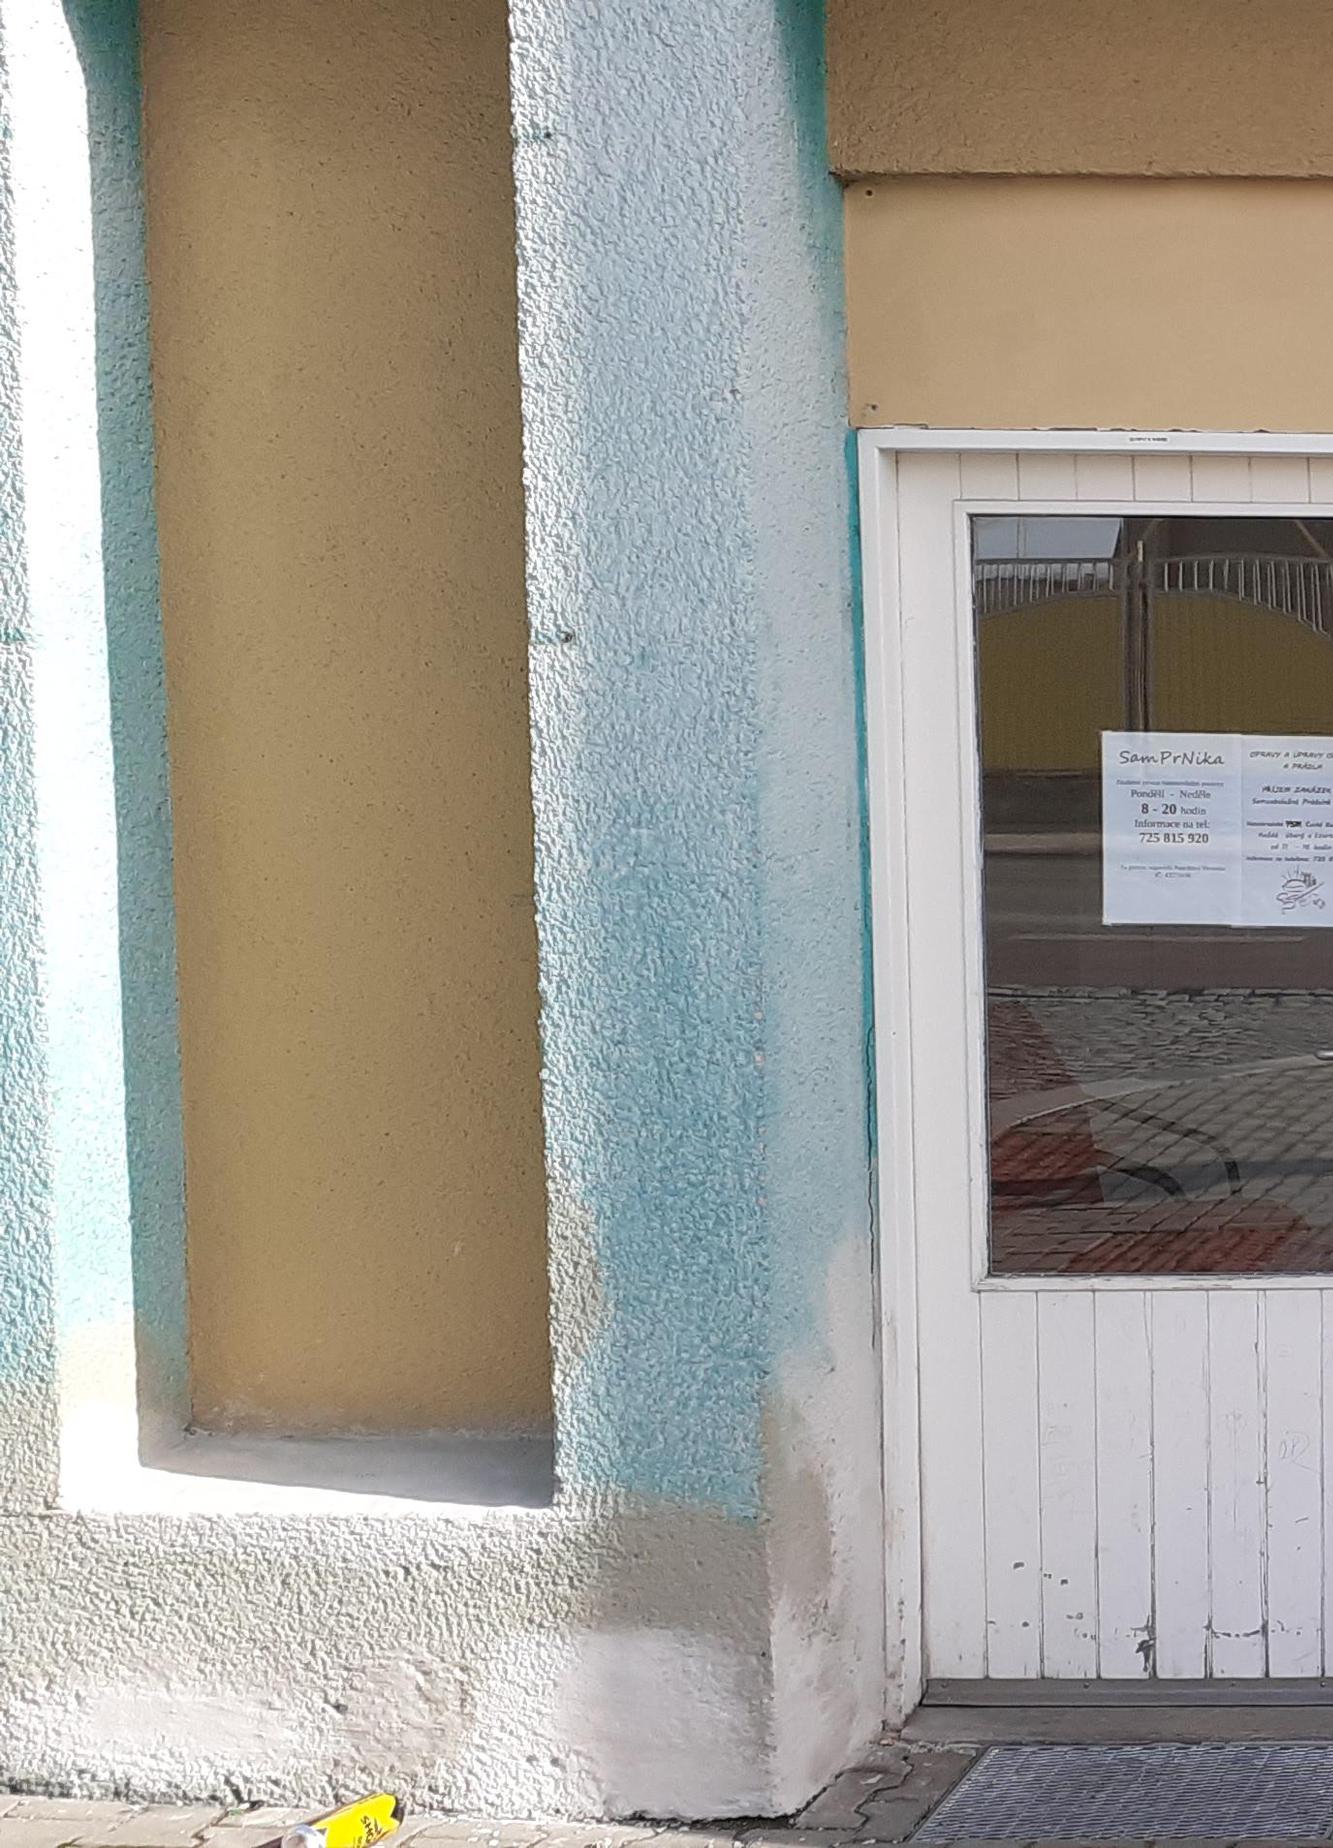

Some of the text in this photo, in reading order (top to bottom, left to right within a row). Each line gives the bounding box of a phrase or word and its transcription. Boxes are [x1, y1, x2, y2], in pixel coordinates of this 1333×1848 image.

[1141, 803, 1149, 815] 8
[1161, 803, 1177, 815] 20
[1134, 819, 1181, 829] Informace
[1139, 832, 1209, 843] 725 815 920
